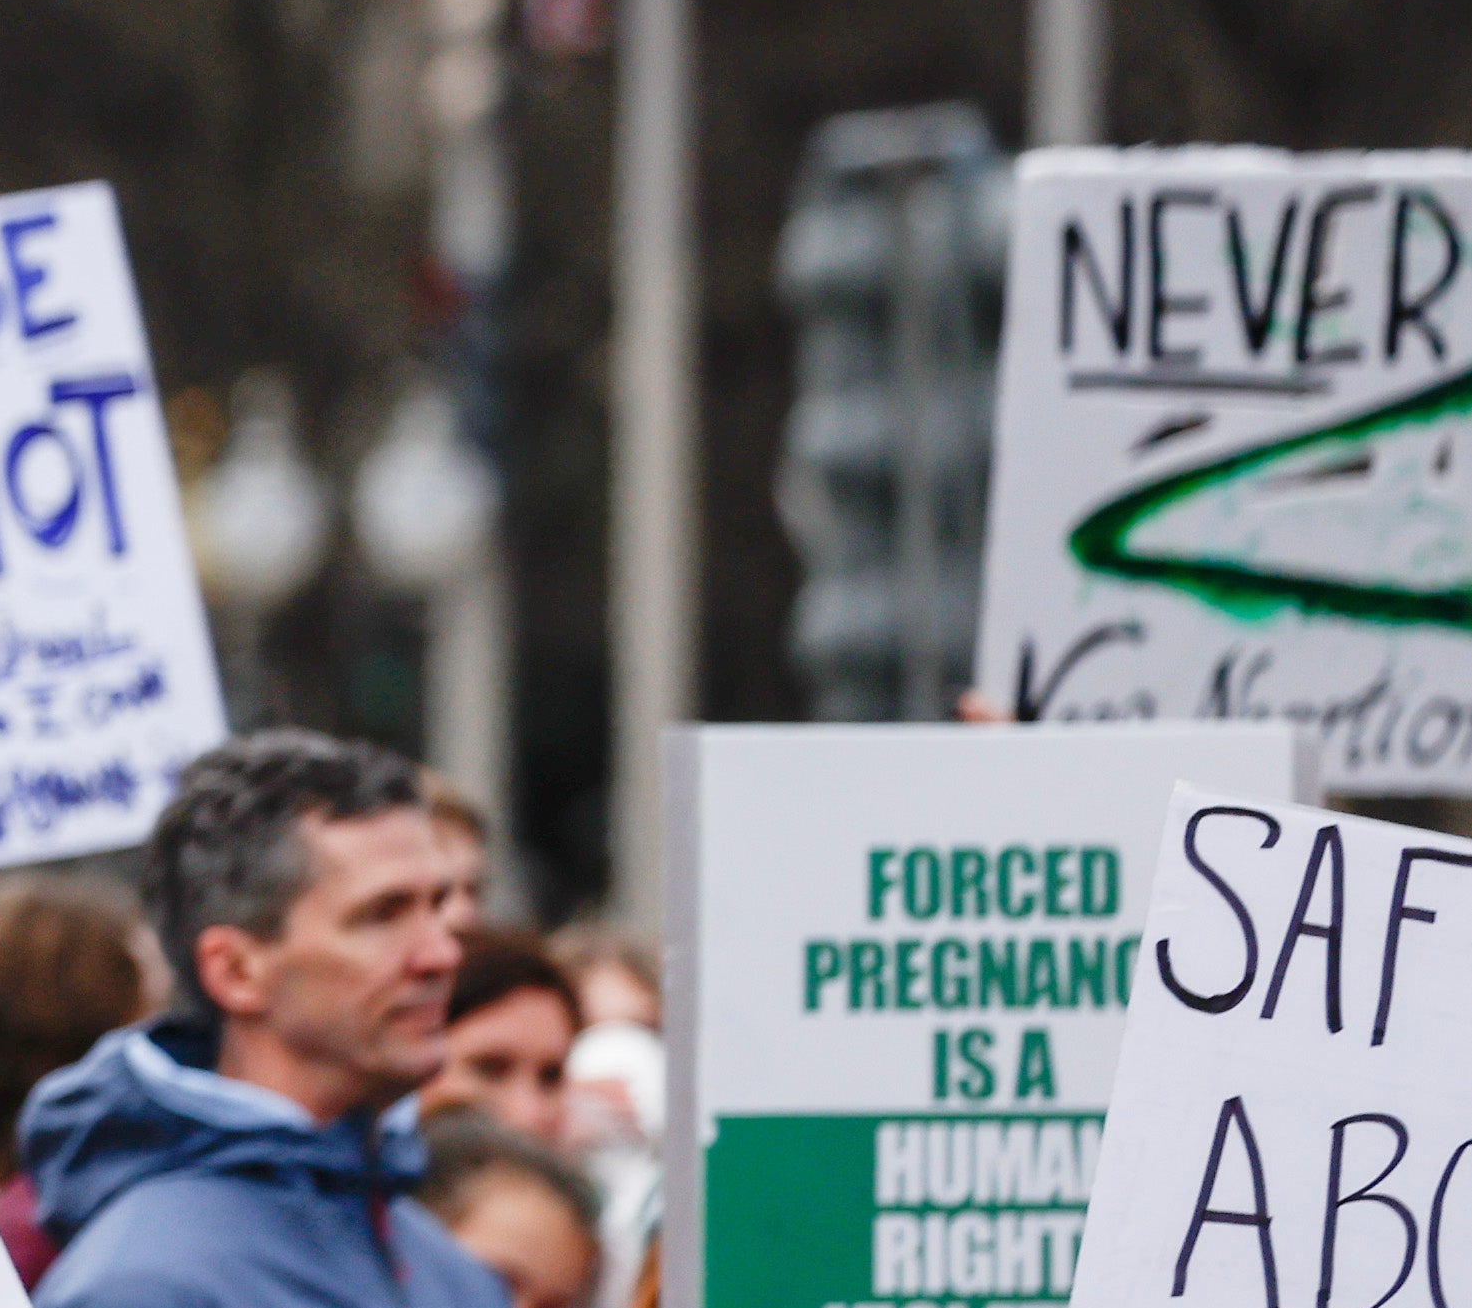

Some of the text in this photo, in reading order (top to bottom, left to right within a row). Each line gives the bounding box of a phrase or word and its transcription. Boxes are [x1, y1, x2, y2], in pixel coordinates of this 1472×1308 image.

[1059, 186, 1463, 364] NEVER
[867, 846, 1120, 920] FORCED
[1155, 806, 1472, 1047] SAF
[933, 1027, 1057, 1102] IS A
